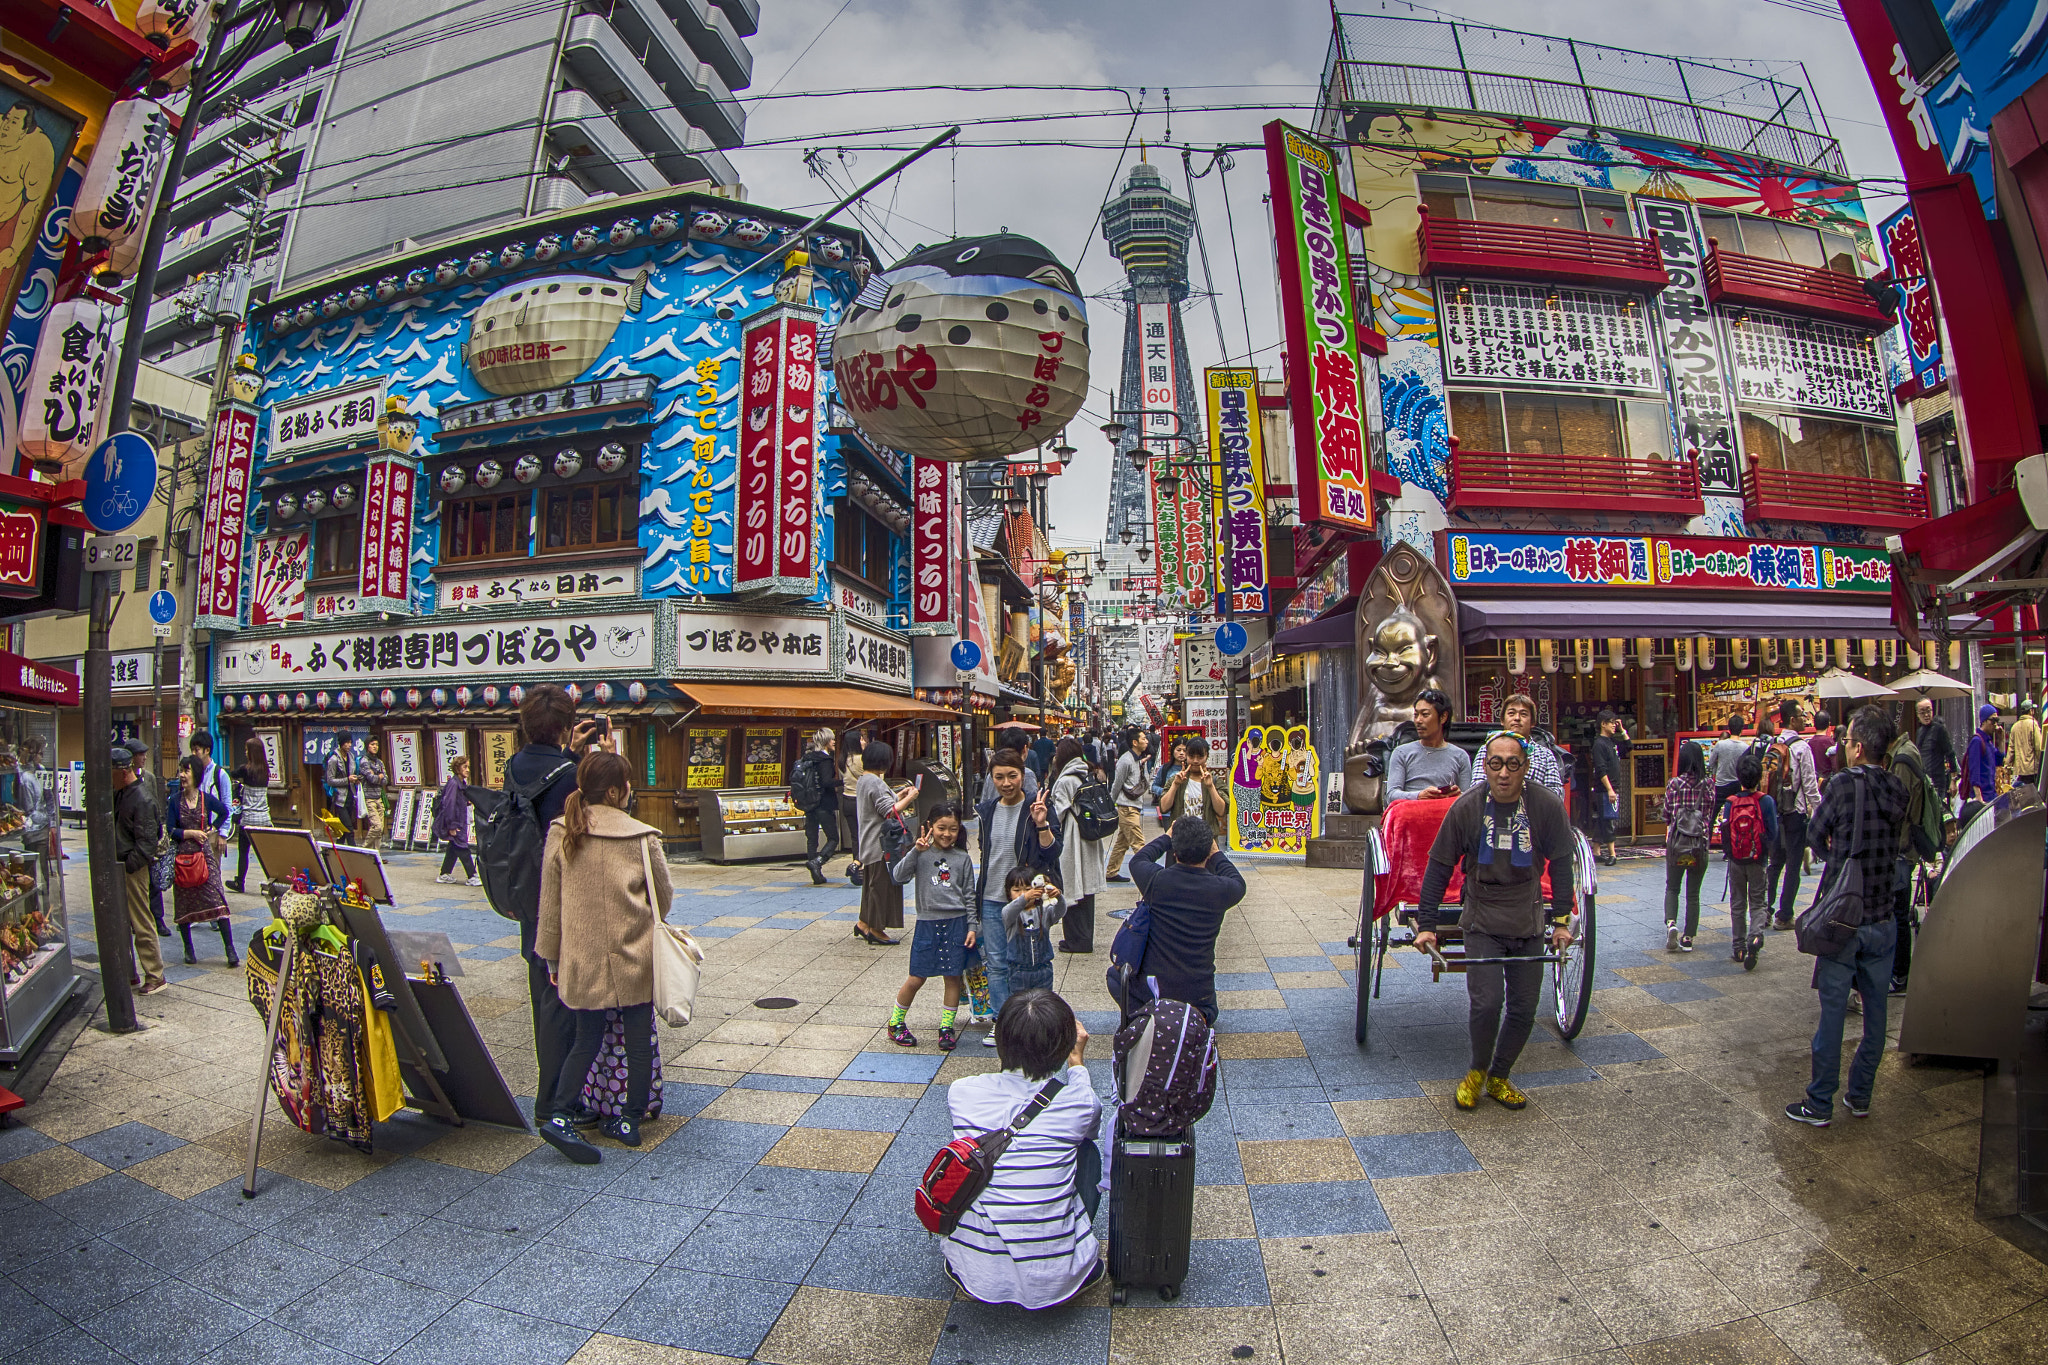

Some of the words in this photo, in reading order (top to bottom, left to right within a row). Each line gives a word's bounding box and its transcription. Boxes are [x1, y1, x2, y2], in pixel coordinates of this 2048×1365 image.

[1287, 132, 1329, 173] 新世界
[1646, 206, 1715, 373] 日本一の串かつ
[788, 333, 812, 391] 名物
[1494, 330, 1511, 376] にんにく
[1017, 331, 1065, 431] づぼらや
[1210, 373, 1253, 388] 新世界
[280, 396, 375, 443] 名物ふぐ寿司
[1313, 344, 1364, 485] 横綱
[1329, 485, 1364, 519] 酒処
[1454, 538, 1468, 578] 新世界
[1470, 546, 1563, 571] 日本一の串かつ
[1565, 540, 1629, 580] 横綱
[1629, 542, 1647, 580] 酒処
[1657, 543, 1670, 581] 新世界
[1672, 551, 1747, 575] 日本一の串かつ
[1751, 546, 1800, 585] 横綱
[1802, 550, 1816, 585] 酒処
[686, 629, 821, 656] づぼらや本店
[846, 632, 906, 679] ふぐ料理専門
[1707, 679, 1750, 692] テーブル席!!
[697, 777, 723, 787] 5,400円
[753, 776, 779, 785] 8,600円
[1266, 811, 1308, 827] 新世界
